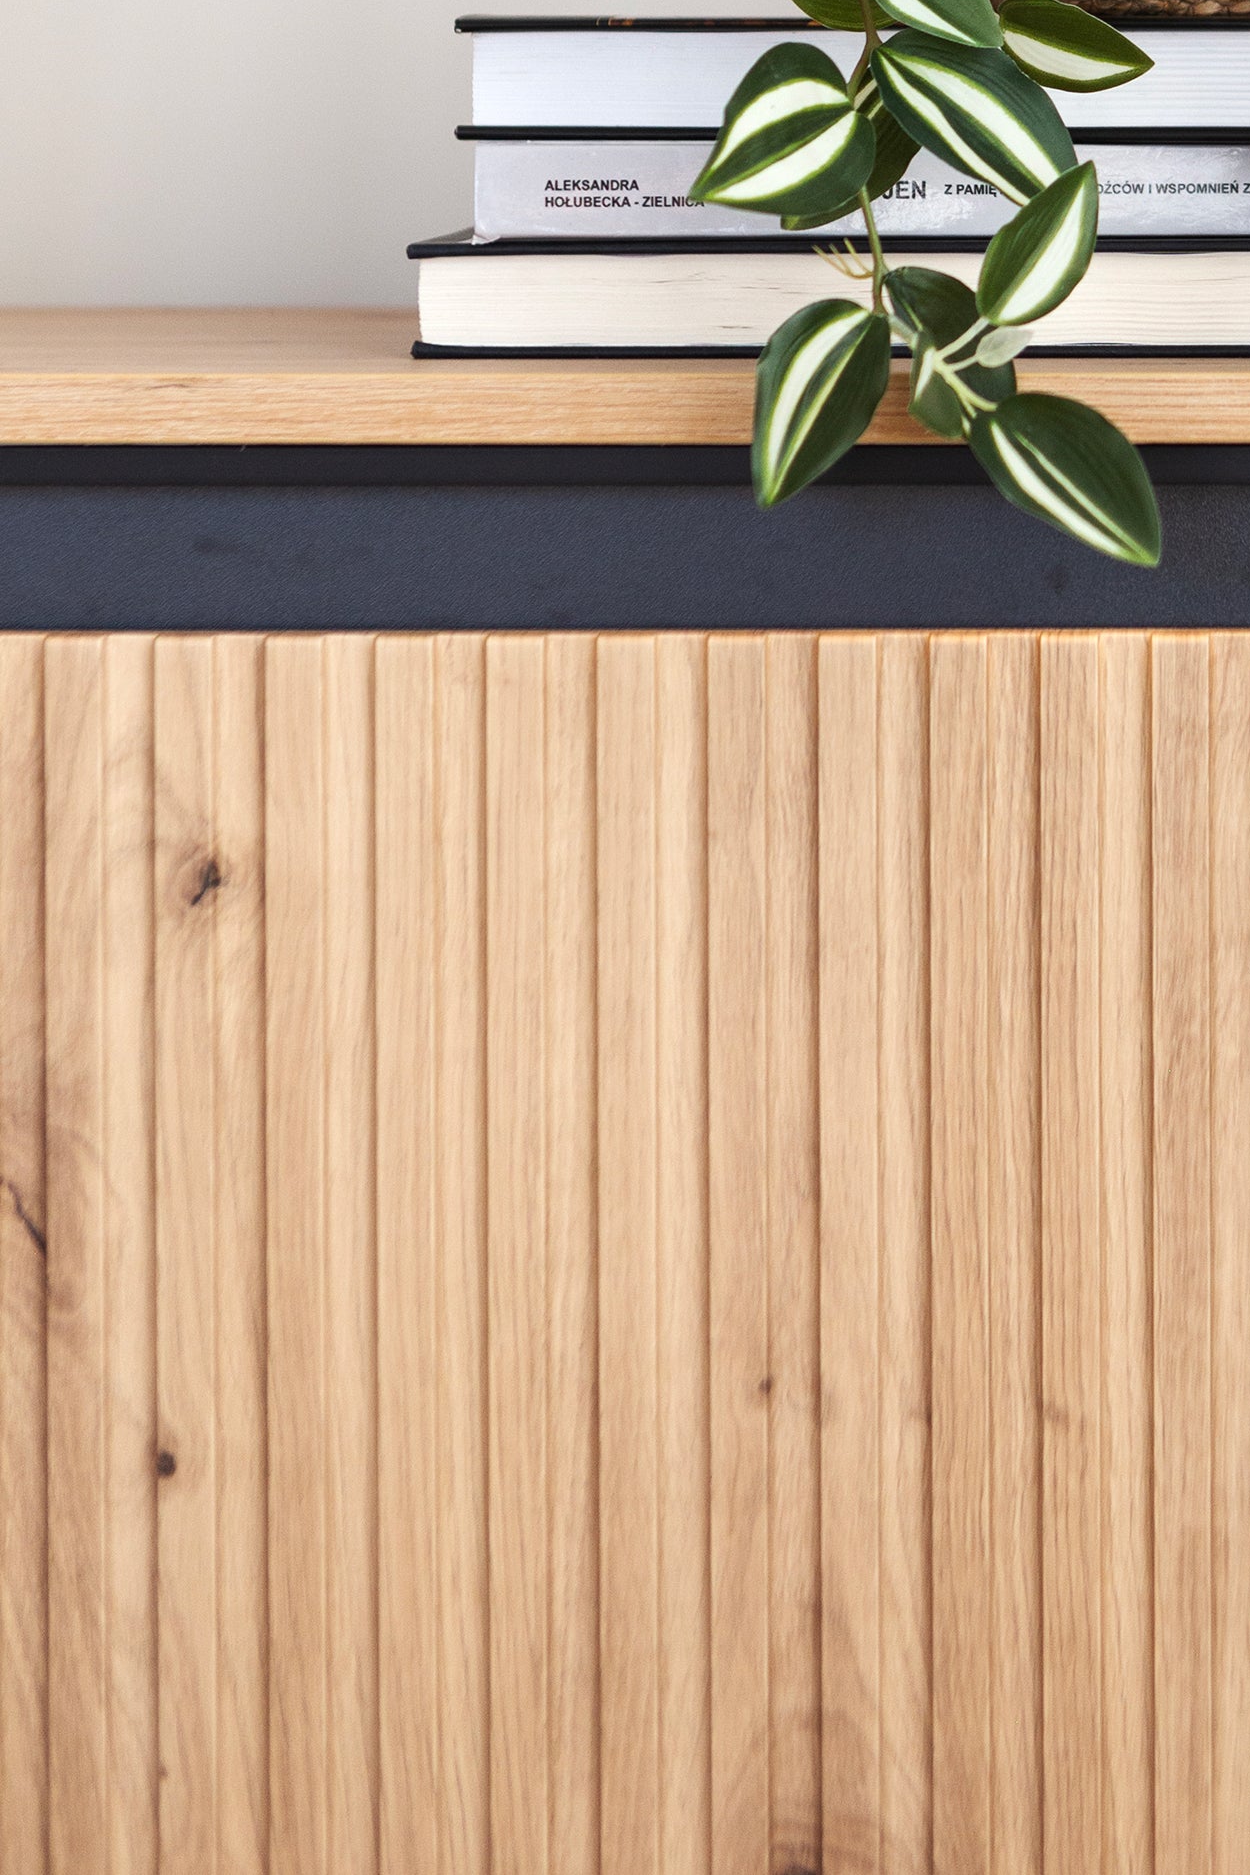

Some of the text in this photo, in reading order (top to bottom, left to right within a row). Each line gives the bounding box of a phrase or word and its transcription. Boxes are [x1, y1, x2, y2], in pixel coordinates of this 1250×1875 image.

[544, 179, 640, 191] ALEKSANDRA
[944, 183, 953, 195] Z
[956, 183, 1003, 198] PAMIĘ
[1155, 180, 1239, 194] WSPOMNIEŃ
[544, 195, 631, 207] HOŁUBECKA
